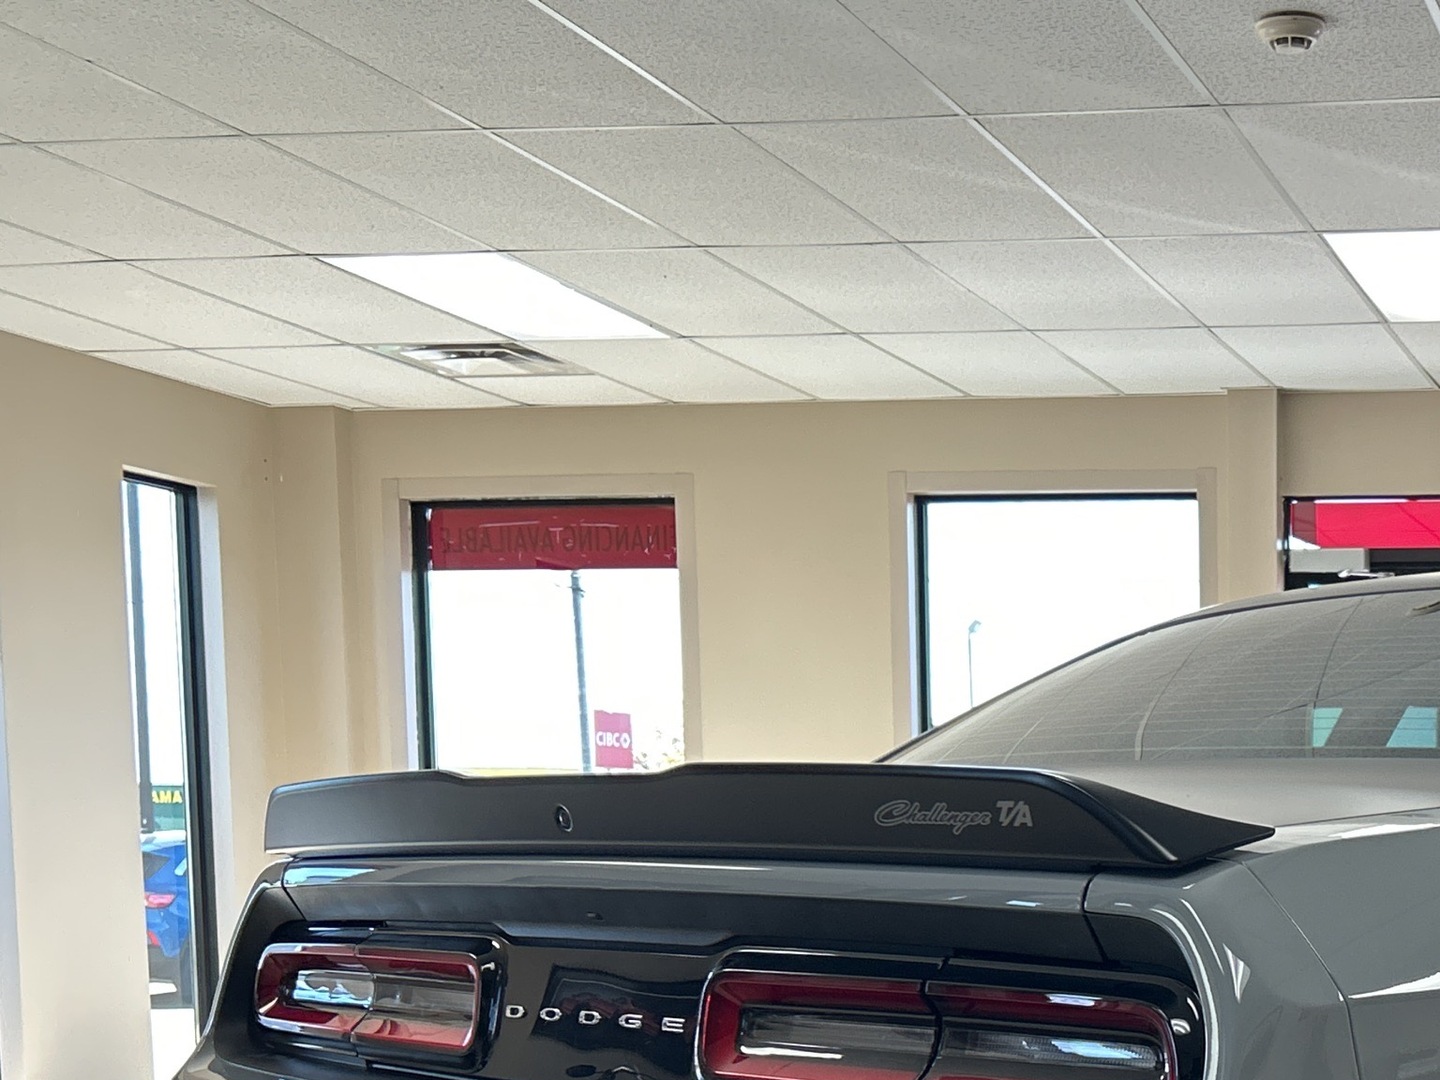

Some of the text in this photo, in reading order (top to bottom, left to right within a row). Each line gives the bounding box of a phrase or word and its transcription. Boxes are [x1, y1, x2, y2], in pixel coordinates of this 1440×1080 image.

[596, 731, 620, 746] CIBC
[874, 800, 992, 836] Challenger
[504, 1004, 686, 1034] DODGE
